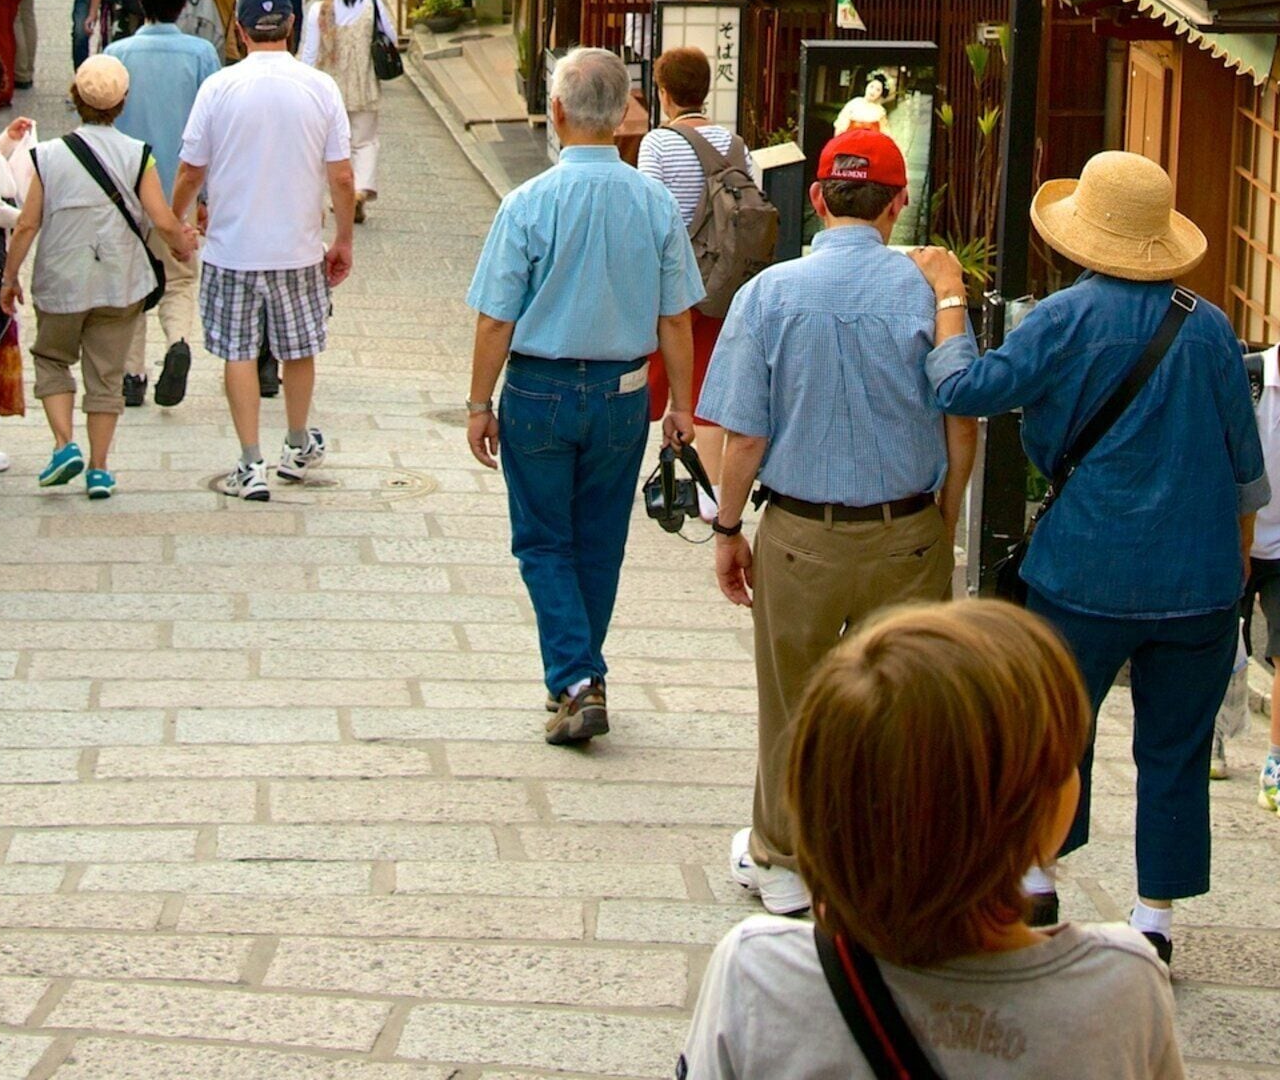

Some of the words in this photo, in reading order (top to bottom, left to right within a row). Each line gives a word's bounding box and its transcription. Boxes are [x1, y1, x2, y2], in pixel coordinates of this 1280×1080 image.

[717, 21, 735, 82] そば処
[830, 168, 868, 179] ALUMNI
